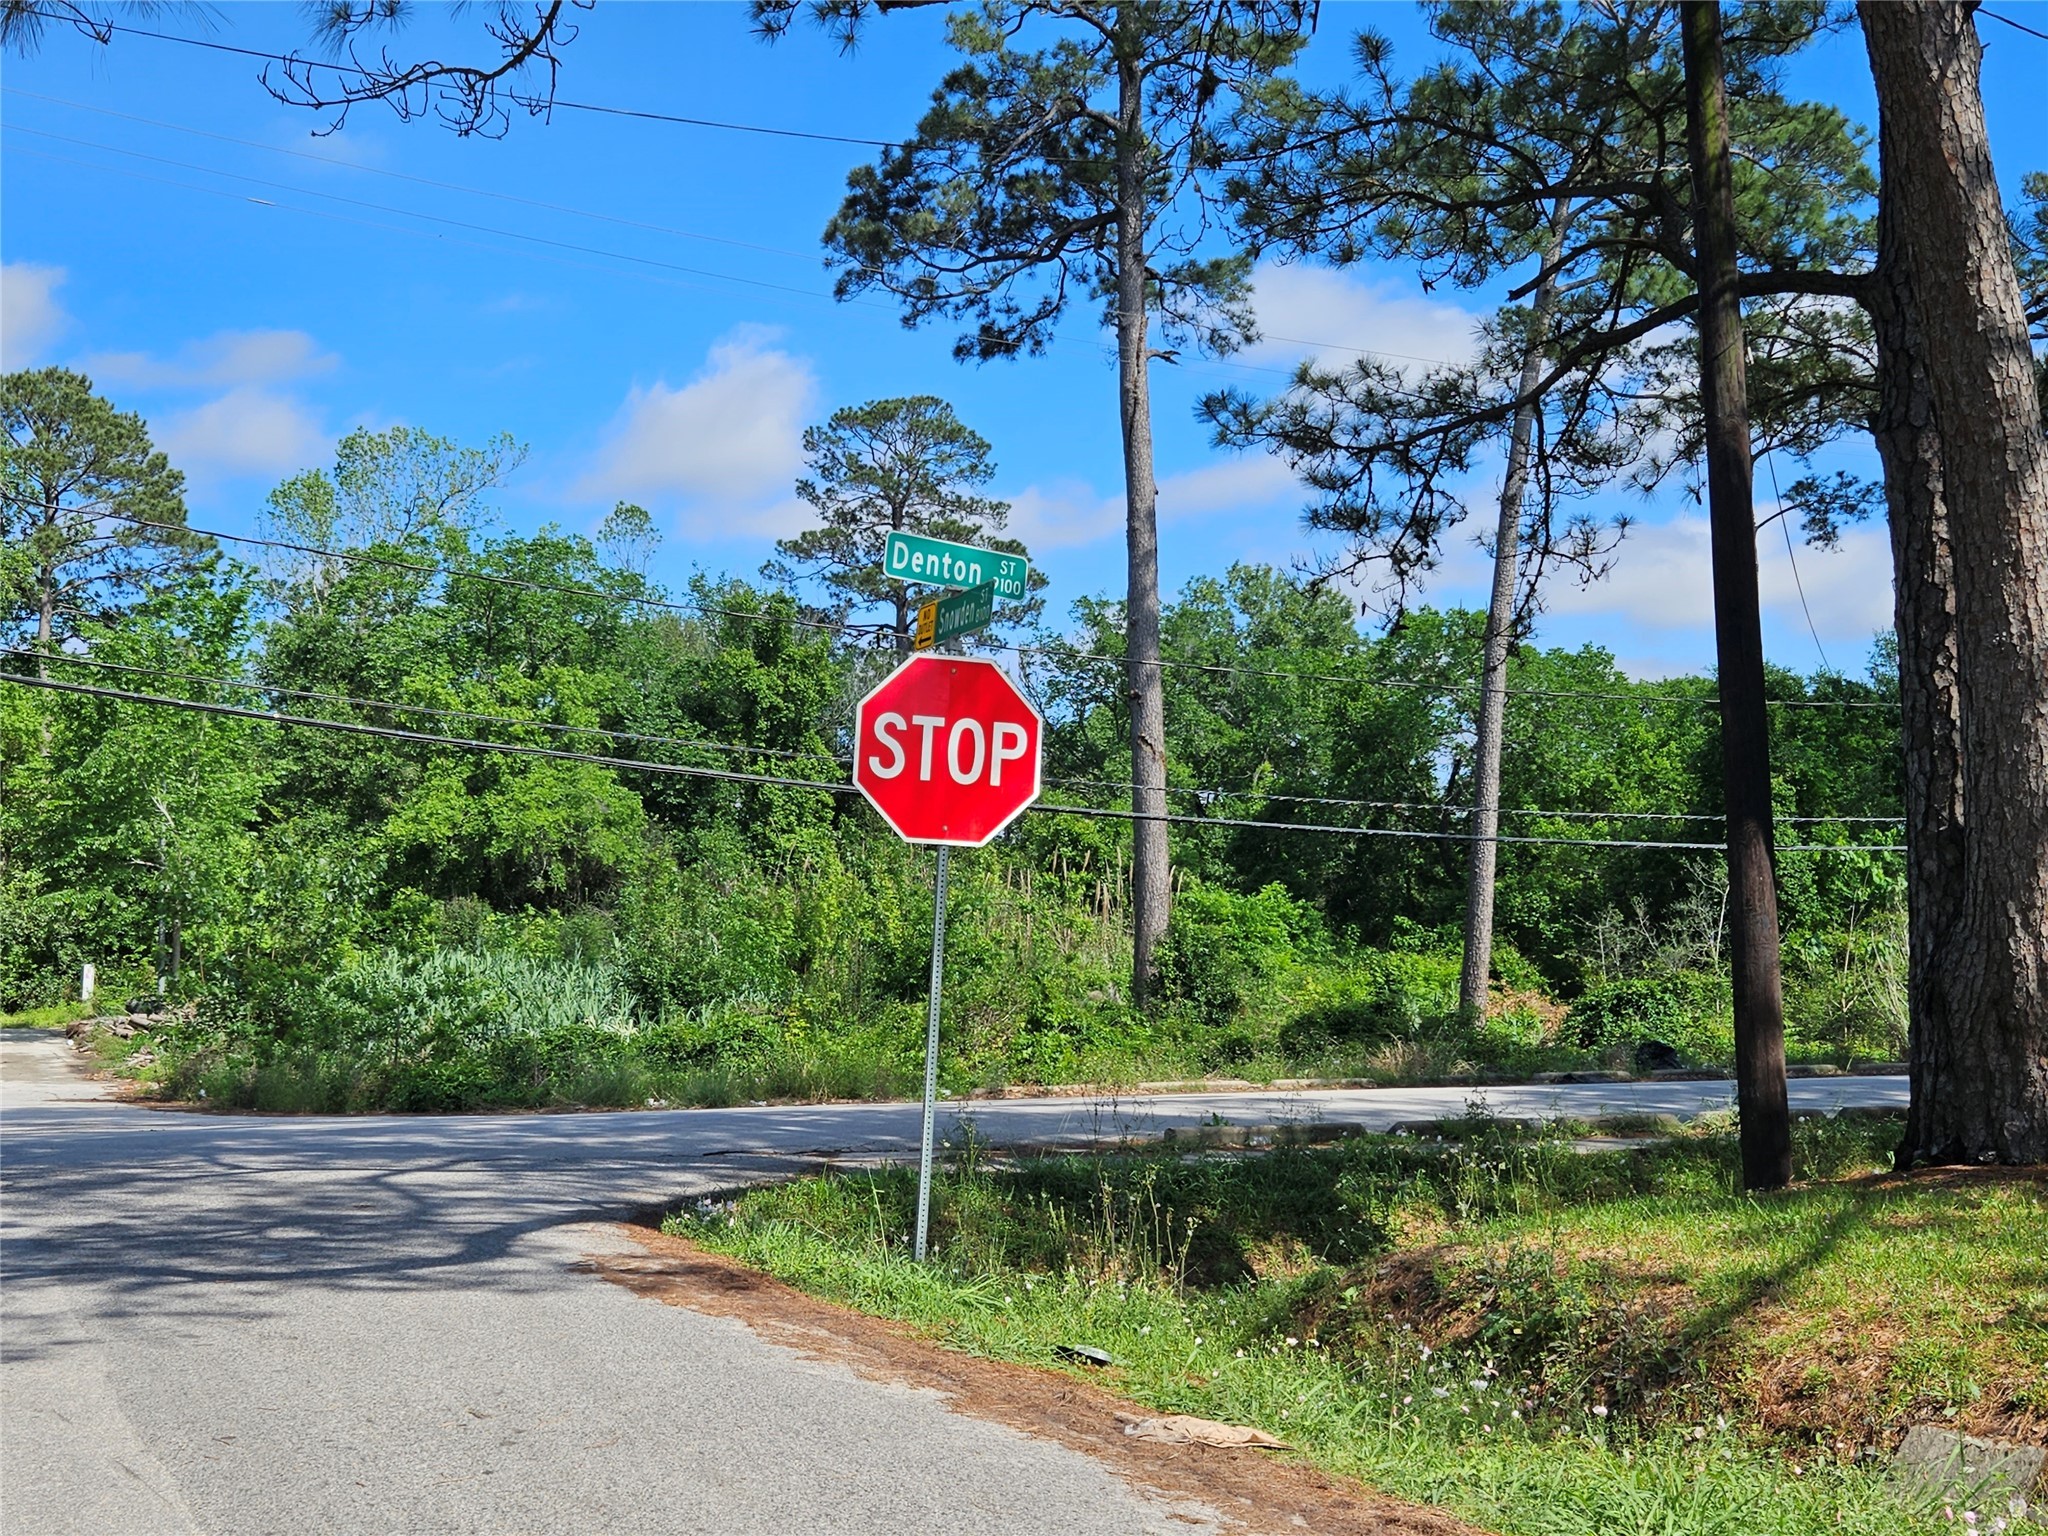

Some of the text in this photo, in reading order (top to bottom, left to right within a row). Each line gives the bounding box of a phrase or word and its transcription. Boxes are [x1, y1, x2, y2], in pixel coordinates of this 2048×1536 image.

[892, 541, 1016, 585] Denton ST
[939, 587, 989, 635] Snowden ST
[868, 711, 1028, 787] STOP
